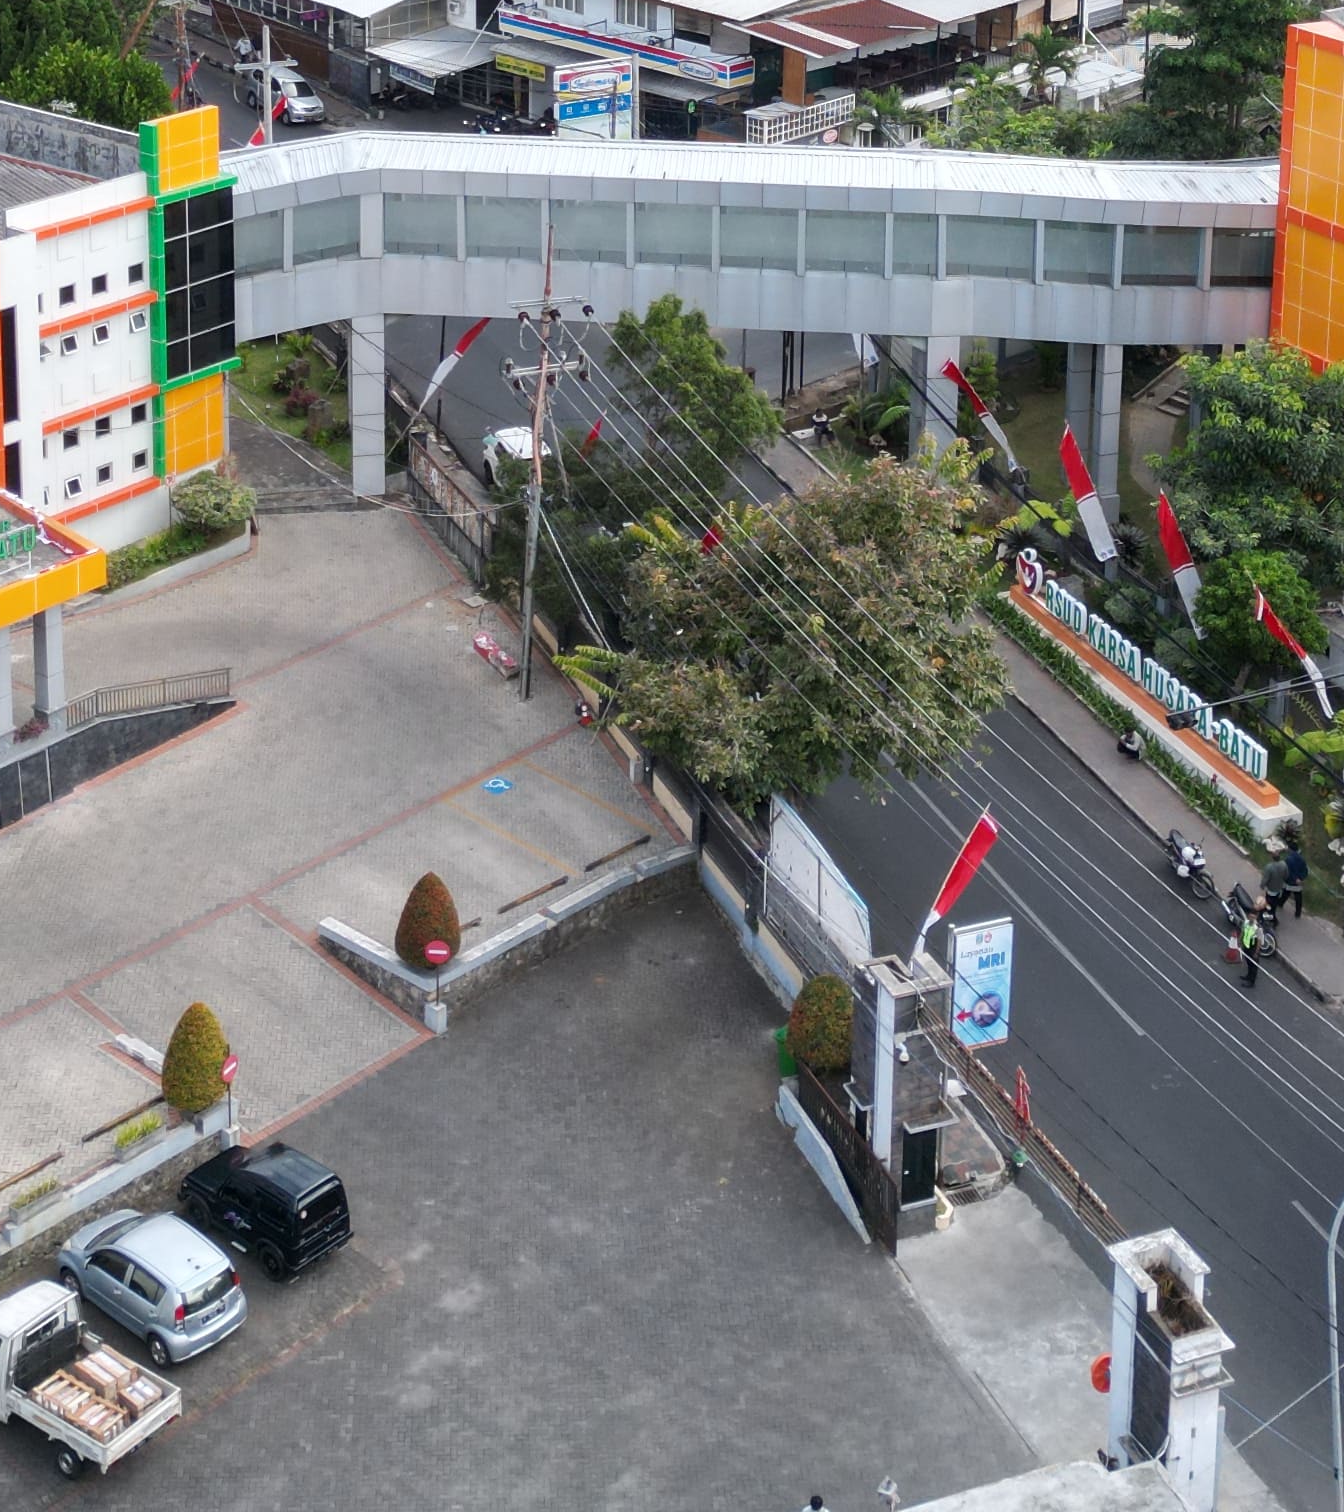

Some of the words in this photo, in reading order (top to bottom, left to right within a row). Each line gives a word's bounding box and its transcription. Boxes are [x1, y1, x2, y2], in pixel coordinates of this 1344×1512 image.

[1045, 579, 1087, 635] RSUD
[1088, 614, 1141, 682] KARSA
[978, 951, 1005, 970] MRI
